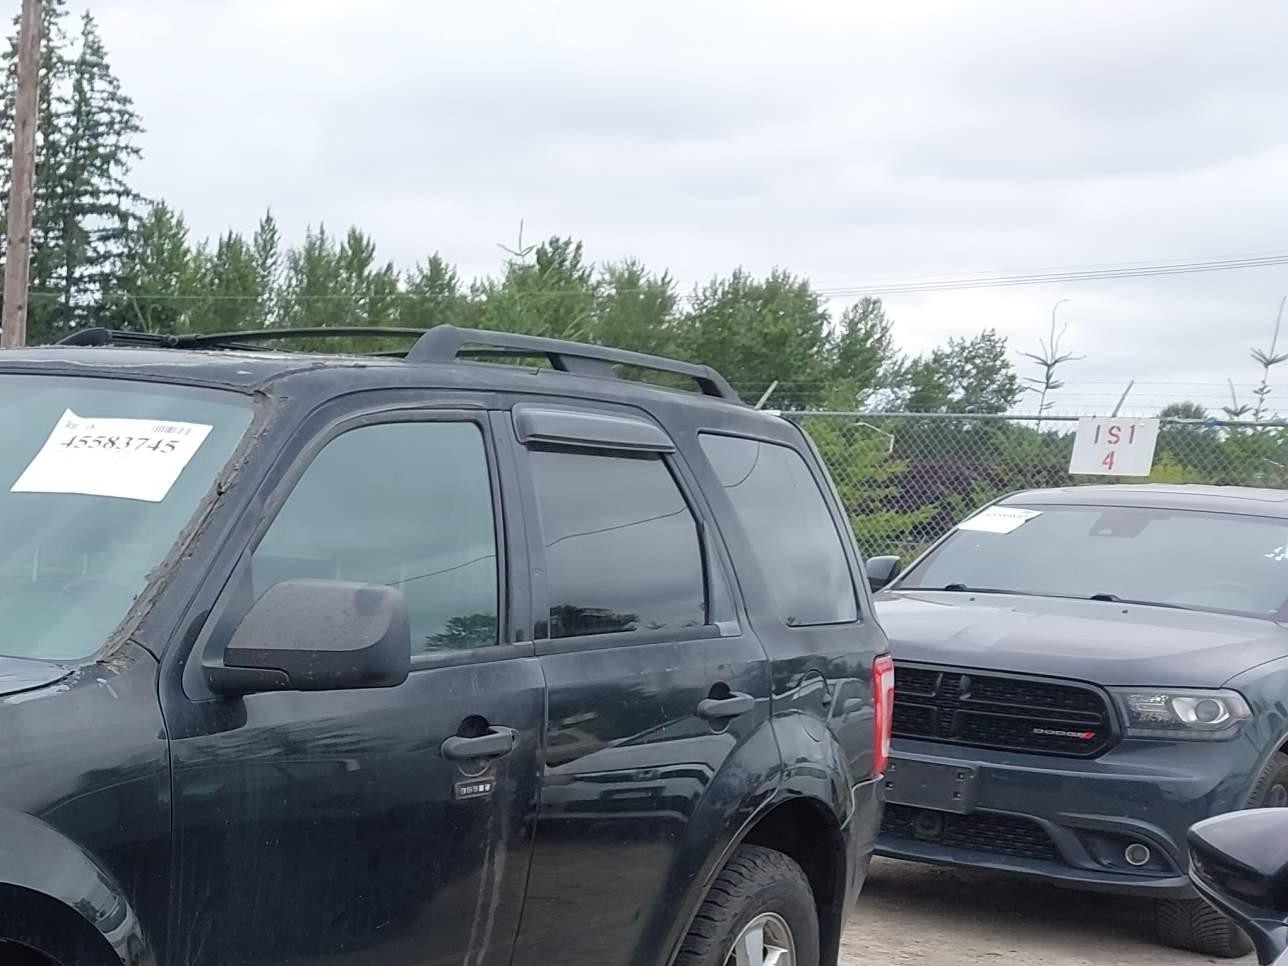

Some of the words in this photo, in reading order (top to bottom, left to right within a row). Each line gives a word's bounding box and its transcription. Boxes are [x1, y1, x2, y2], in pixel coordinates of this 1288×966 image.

[61, 434, 180, 454] 45583745
[1101, 450, 1115, 471] 4
[1032, 727, 1084, 739] DODGE
